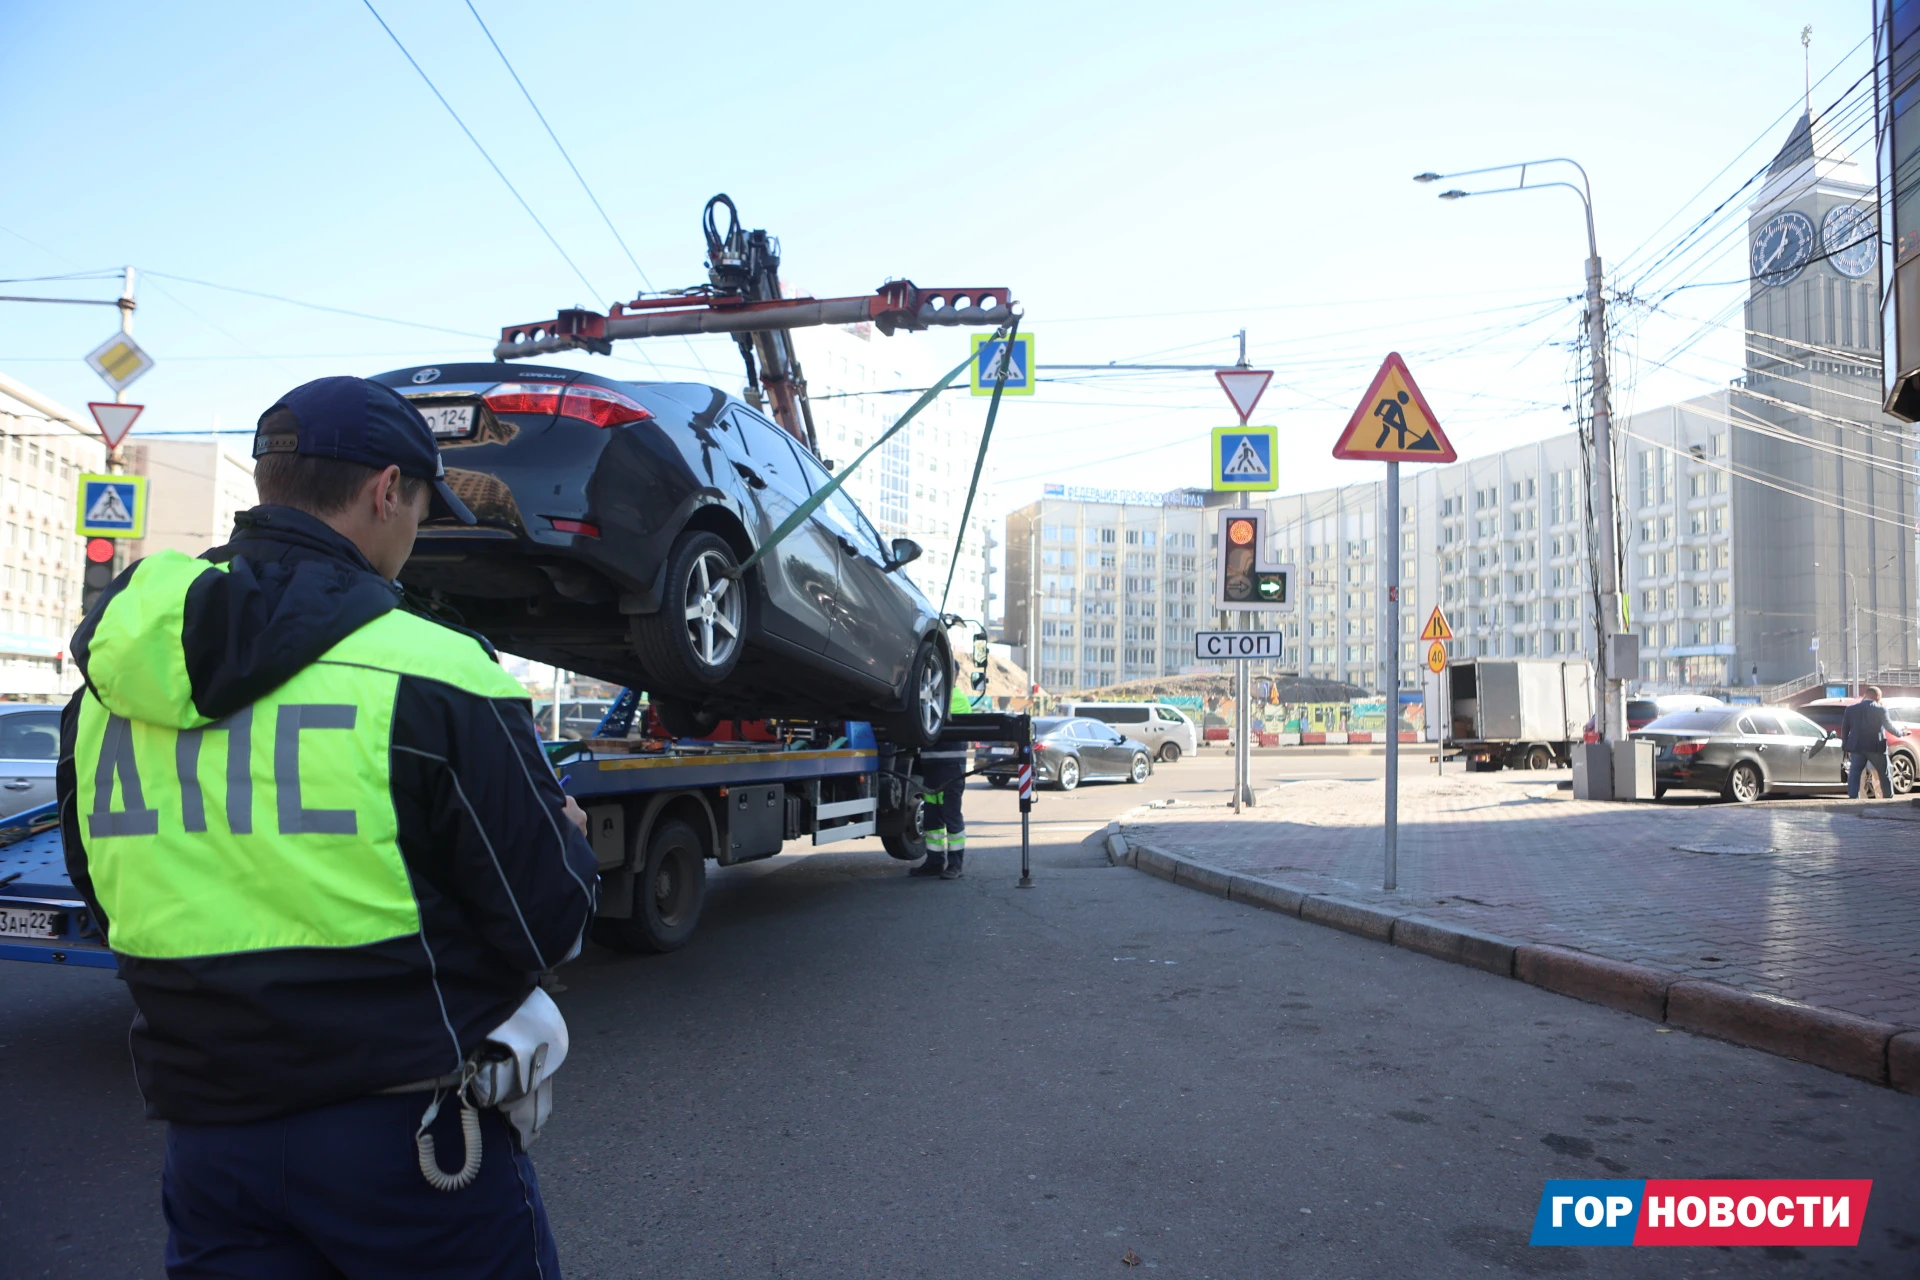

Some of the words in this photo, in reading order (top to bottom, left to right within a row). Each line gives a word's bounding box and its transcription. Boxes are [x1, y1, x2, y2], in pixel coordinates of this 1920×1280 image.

[440, 409, 466, 425] 124
[1207, 636, 1270, 655] СТОП
[1431, 650, 1443, 664] 40
[87, 704, 358, 839] ДПС
